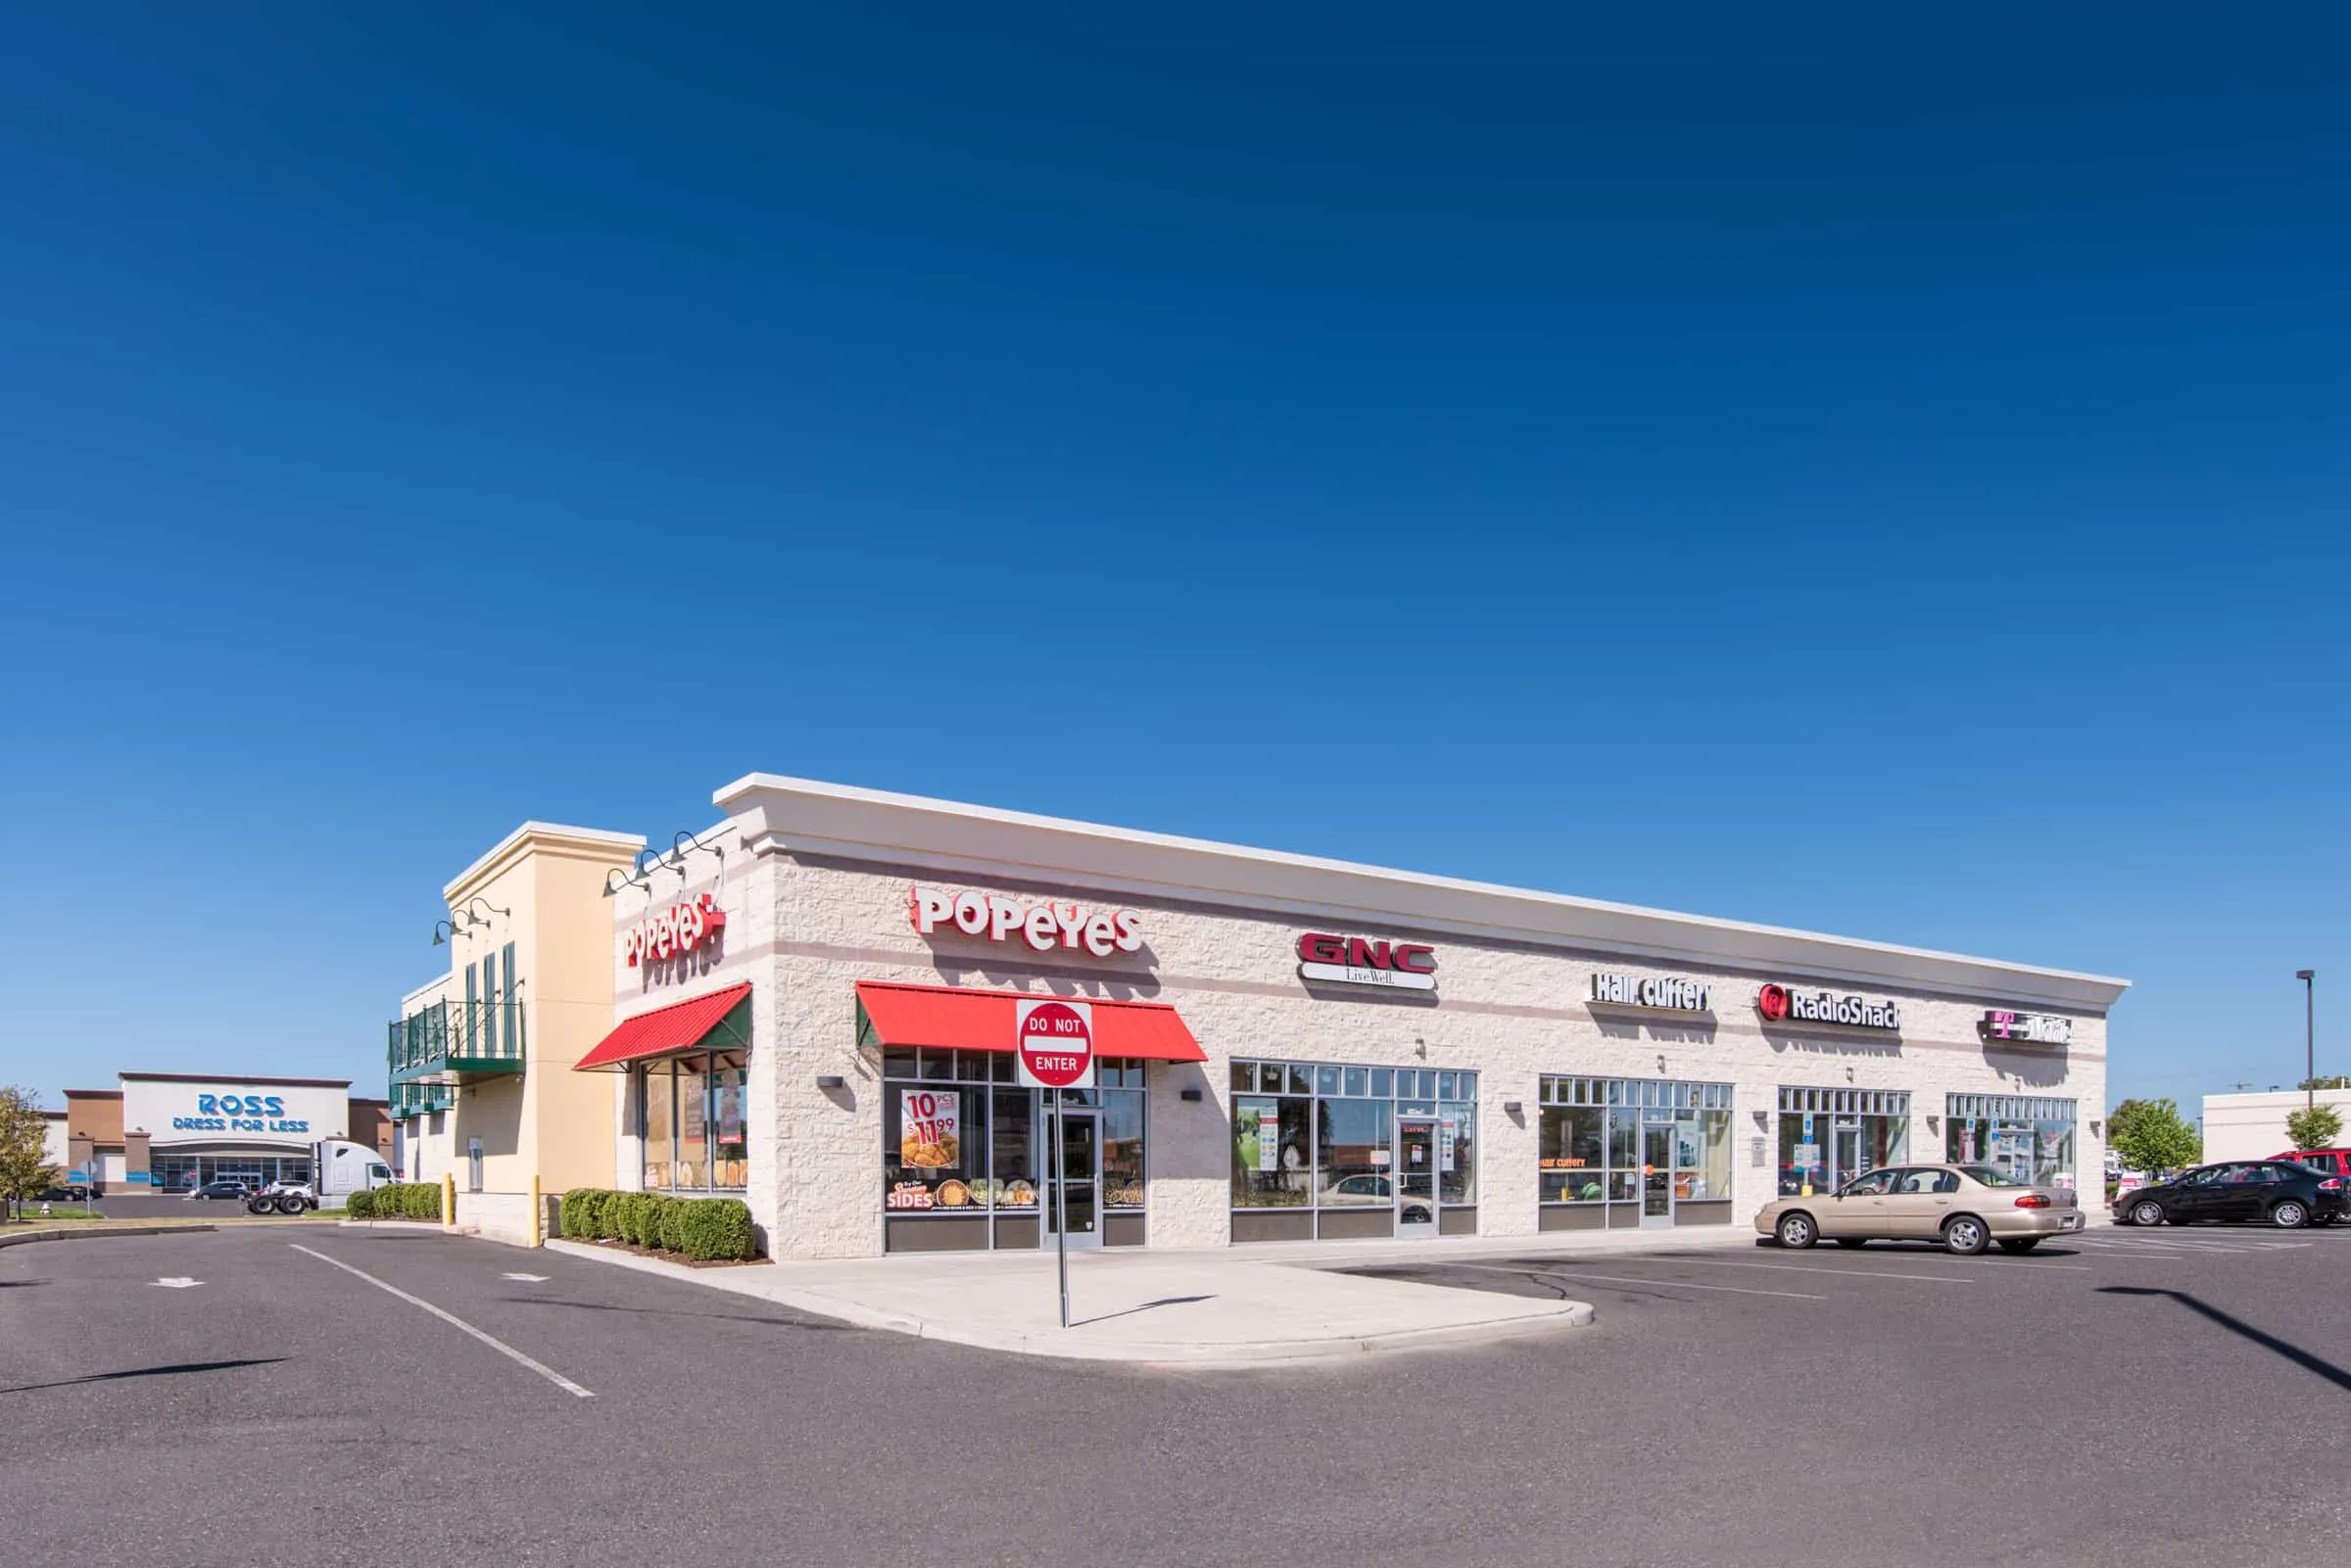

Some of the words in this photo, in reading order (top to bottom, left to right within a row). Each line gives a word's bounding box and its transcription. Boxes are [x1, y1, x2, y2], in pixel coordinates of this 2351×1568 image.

[1300, 932, 1435, 974] GNC
[1593, 972, 1639, 1005] Hair
[1792, 989, 1902, 1029] RadioShack
[1029, 1018, 1048, 1031] DO
[1055, 1019, 1081, 1033] NOT
[1034, 1056, 1078, 1071] ENTER
[198, 1094, 284, 1117] ROSS
[907, 1093, 936, 1118] 10
[172, 1117, 226, 1131] DRESS
[231, 1118, 264, 1132] FOR
[268, 1119, 310, 1133] LESS
[887, 1192, 934, 1208] SIDES
